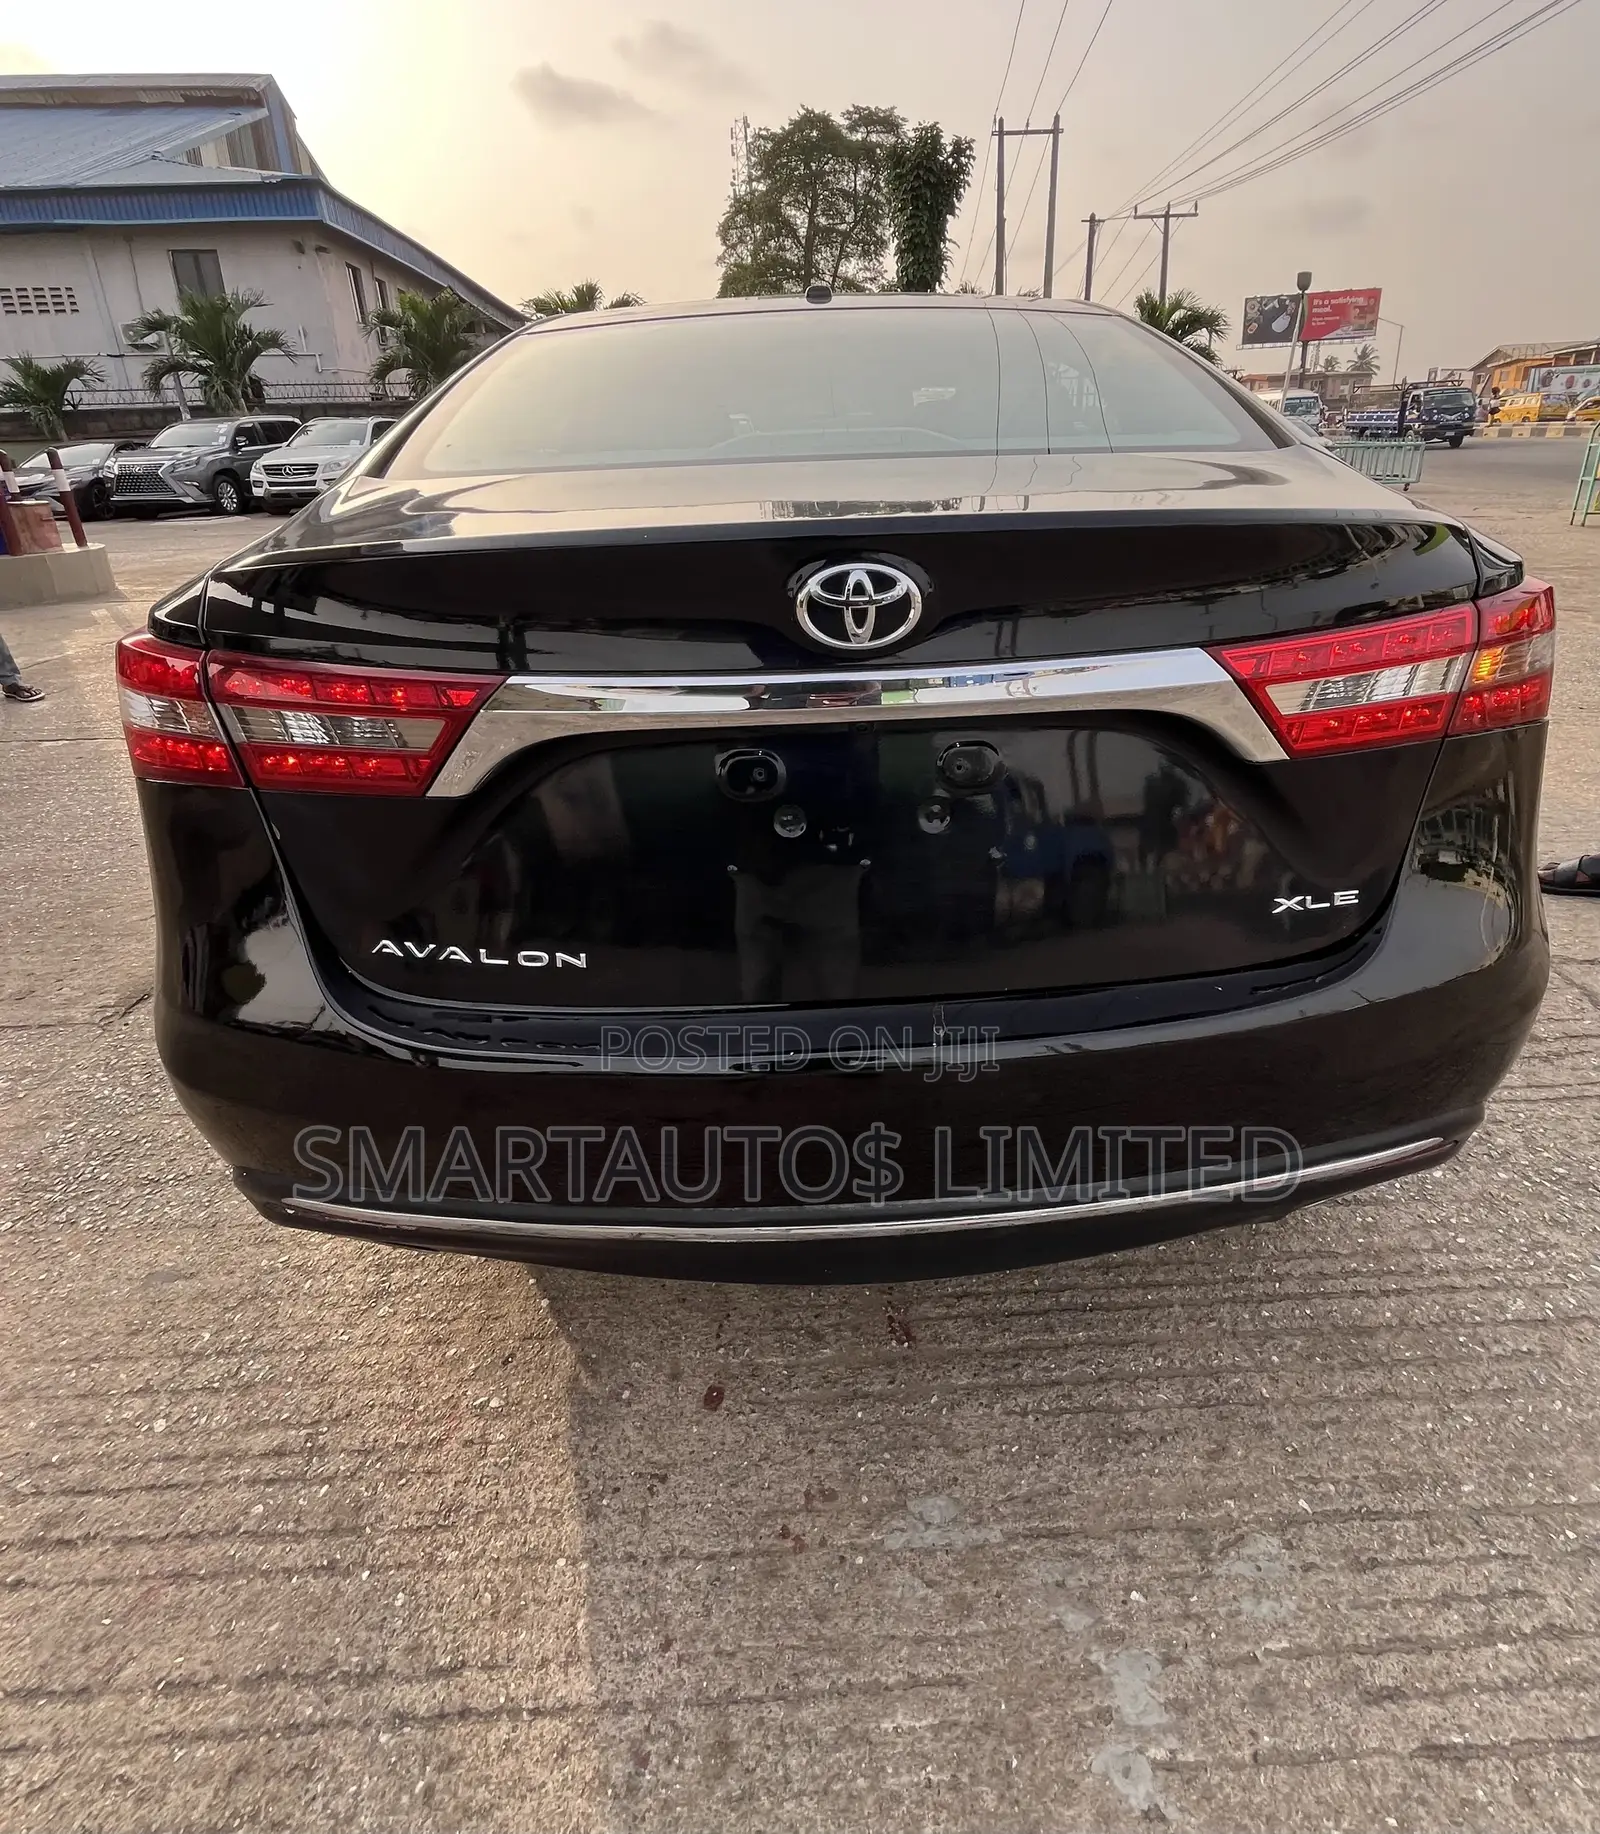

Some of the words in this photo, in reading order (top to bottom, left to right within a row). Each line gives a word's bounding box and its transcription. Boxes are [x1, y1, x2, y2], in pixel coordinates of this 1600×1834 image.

[1330, 296, 1364, 305] satisfying
[1271, 889, 1360, 914] XLE
[371, 939, 587, 969] AVALON
